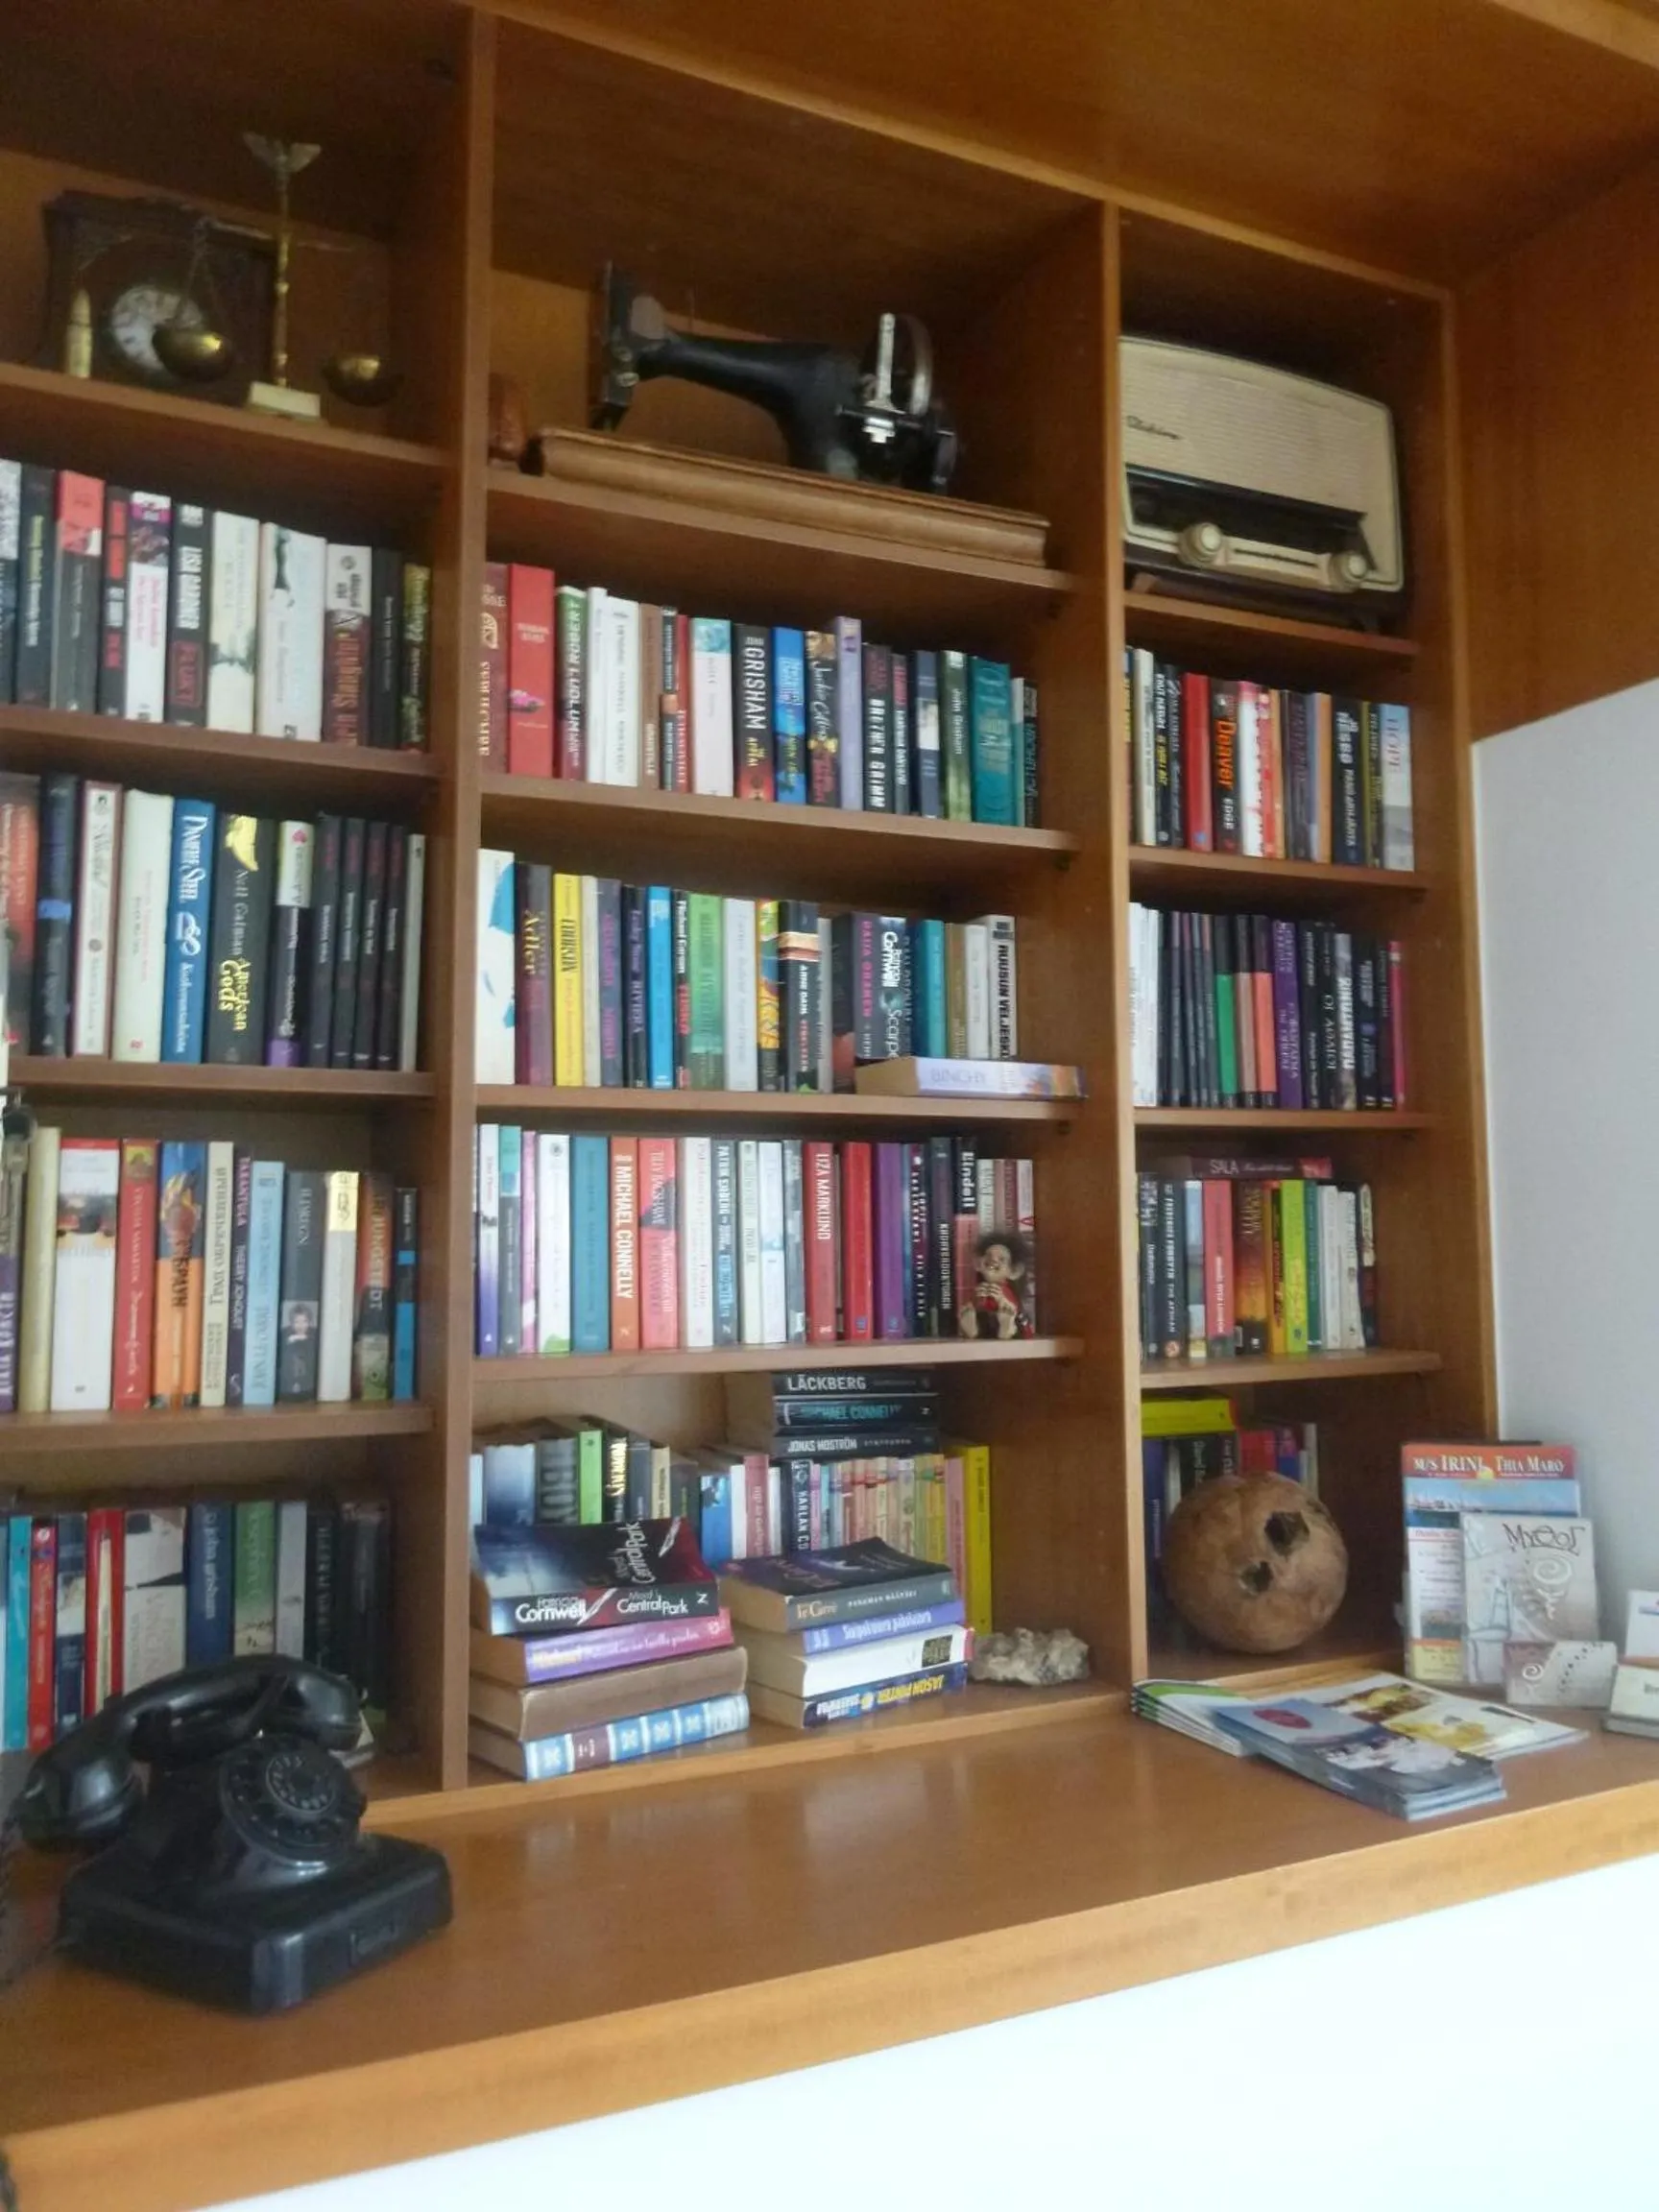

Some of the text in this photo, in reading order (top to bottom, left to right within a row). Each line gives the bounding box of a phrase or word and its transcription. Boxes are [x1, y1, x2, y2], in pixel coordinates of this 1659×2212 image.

[179, 546, 203, 630] LISA GARDNER
[568, 600, 582, 664] ROBERT
[179, 644, 195, 704] FLUKT
[331, 637, 363, 708] Slaughter
[566, 666, 582, 733] LUDLUM
[744, 647, 767, 730] GRISHAM
[811, 661, 834, 741] Jackie Collins
[951, 687, 963, 755] John Grisham
[868, 698, 886, 807] BROTHER GRIMM
[1215, 718, 1238, 830] Deaver EDGE
[231, 870, 249, 955] Neil Gaiman
[523, 909, 541, 976] Adler
[219, 960, 238, 1011] Gods
[233, 957, 252, 1030] American
[799, 964, 808, 990] ARNE
[882, 931, 903, 1059] Cornwell Scarpe
[998, 945, 1010, 998] RUUSUN
[633, 980, 643, 1034] RIVIERA
[799, 991, 808, 1016] DAHL
[930, 1068, 988, 1085] BINCHY
[651, 1151, 665, 1225] TILLY BAGSHAWE
[717, 1145, 730, 1177] PATRIK
[961, 1152, 975, 1208] Lindell
[298, 1189, 314, 1245] ILDREGN
[816, 1153, 831, 1239] LIZA MARKLUND
[1166, 1197, 1174, 1238] FREDERICK
[232, 1157, 251, 1331] TARANTULA THIERRY JONQUET
[614, 1165, 634, 1299] MICHAEL CONNELLY
[1166, 1239, 1175, 1279] FORSYTH
[172, 1258, 190, 1307] БРАУН
[369, 1214, 386, 1311] JUNGSTEDT
[1167, 1300, 1176, 1333] AFGHAN
[787, 1374, 867, 1392] LÄCKBERG
[787, 1439, 816, 1453] JONAS
[817, 1436, 857, 1452] MOSTRÖM
[1439, 1455, 1483, 1472] IRINI
[1496, 1455, 1525, 1472] THIA
[1527, 1455, 1565, 1473] MARO
[616, 1522, 648, 1547] Park
[797, 1489, 809, 1532] HARLAN
[204, 1527, 219, 1621] john grisham
[614, 1548, 657, 1584] Central
[516, 1599, 587, 1623] Cornwell
[617, 1597, 688, 1617] Central Park
[628, 1591, 653, 1601] Mord
[797, 1603, 808, 1619] le
